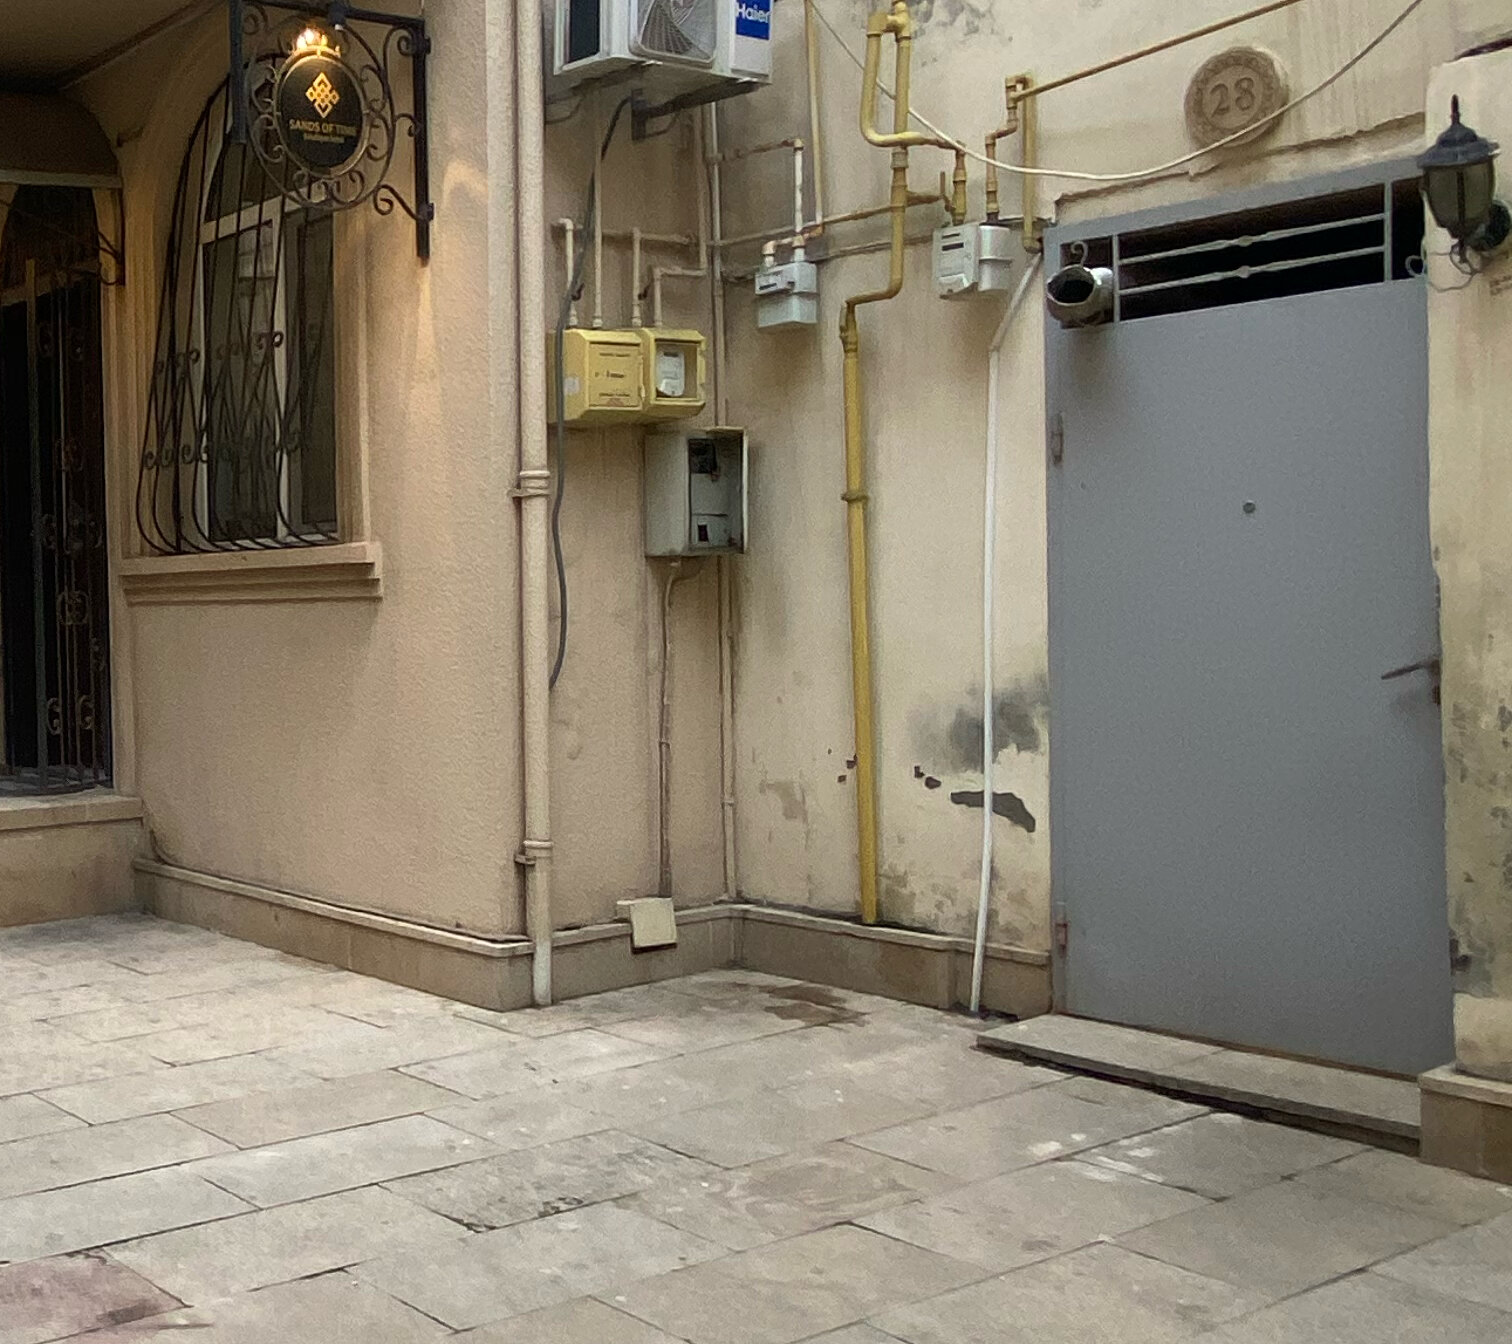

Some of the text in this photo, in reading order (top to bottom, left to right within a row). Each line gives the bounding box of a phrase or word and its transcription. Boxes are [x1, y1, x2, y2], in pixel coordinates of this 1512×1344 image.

[736, 2, 772, 24] Haier
[1209, 76, 1256, 118] 28
[289, 119, 320, 132] SANDS
